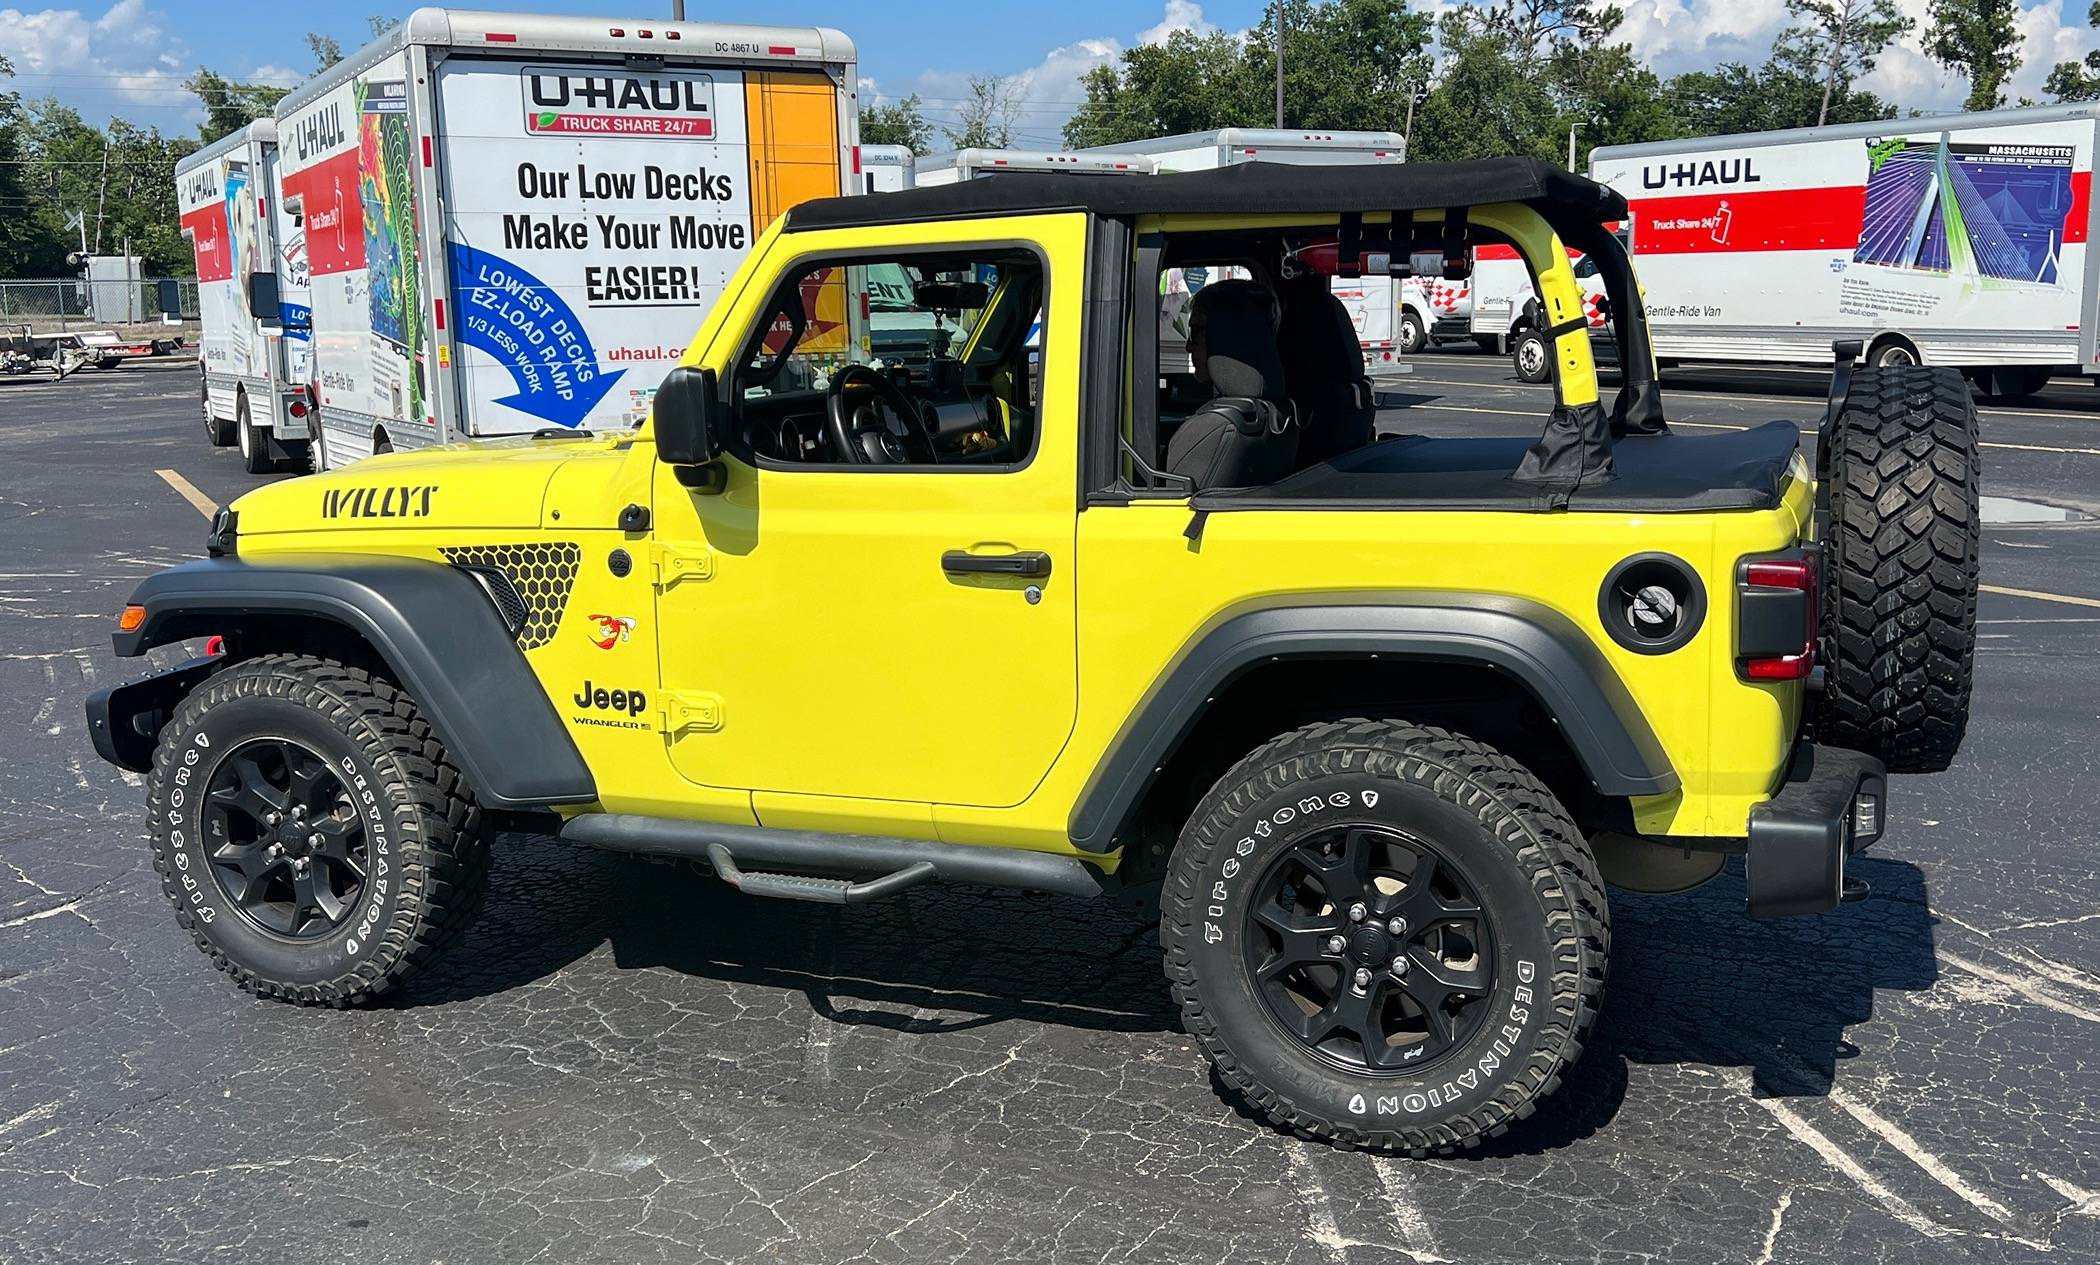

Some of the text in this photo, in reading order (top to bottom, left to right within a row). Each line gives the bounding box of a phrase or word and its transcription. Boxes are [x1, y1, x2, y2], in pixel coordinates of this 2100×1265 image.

[715, 42, 759, 54] DC 4867 U
[531, 75, 708, 112] U-HAUL
[296, 102, 345, 160] U-HAUL
[561, 117, 694, 134] TRUCK SHARE 24/7
[1988, 145, 2072, 157] MASSACHUSETTS
[188, 168, 217, 204] U-HAUL
[517, 162, 733, 201] Our Low Decks
[1643, 158, 1760, 189] U-HAUL
[503, 214, 745, 250] Make Your Move
[1652, 220, 1675, 230] Truck
[1676, 218, 1700, 229] Share
[585, 266, 701, 301] EASIER!
[868, 281, 905, 300] ENT
[1483, 296, 1511, 305] Gentle-
[479, 265, 594, 383] LOWEST DECKS
[1645, 305, 1721, 317] Gentle-Ride Van
[1840, 307, 1879, 317] uhaul.com
[467, 315, 543, 394] 1/3 LESS WORK
[471, 287, 574, 401] EZ-LOAD RAMP
[608, 346, 688, 361] uhaul.c
[322, 486, 439, 518] WILLYS
[573, 680, 646, 717] Jeep
[573, 716, 639, 729] WRANGLER
[168, 749, 216, 923] Firestone
[341, 756, 389, 941] DESTINATION
[1204, 791, 1351, 944] Firestone
[1377, 960, 1535, 1116] DESTINATION
